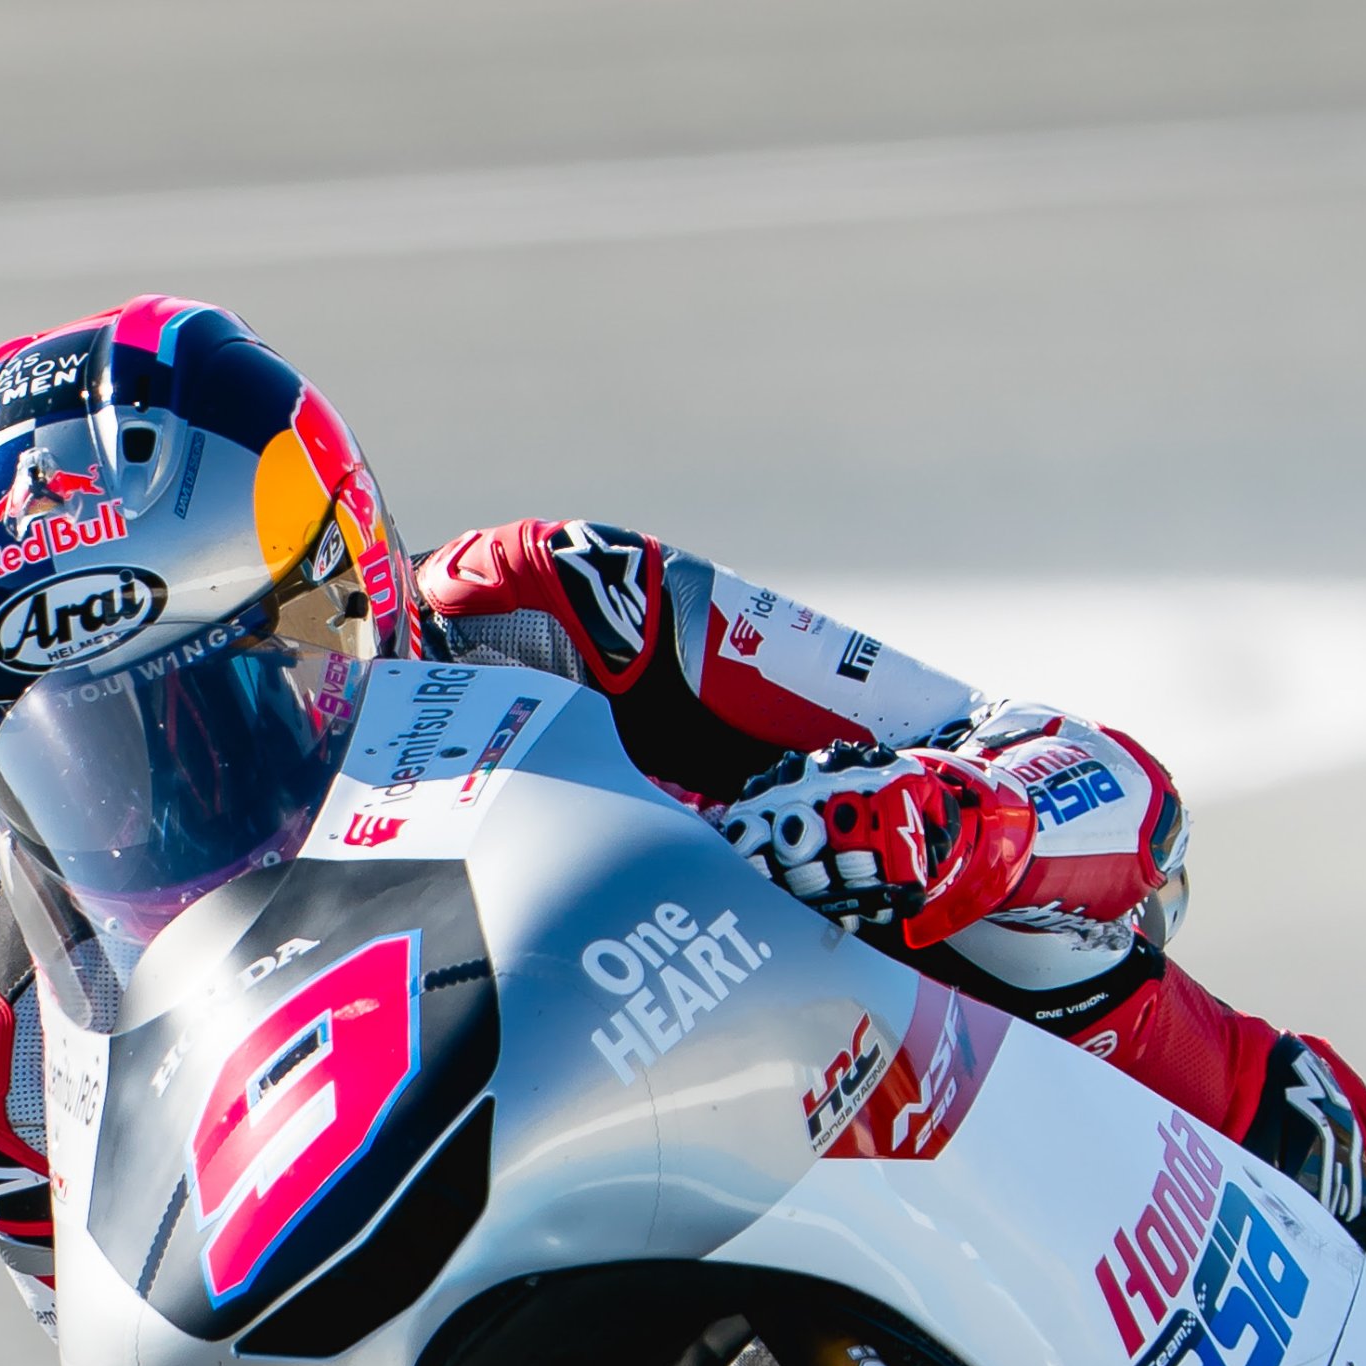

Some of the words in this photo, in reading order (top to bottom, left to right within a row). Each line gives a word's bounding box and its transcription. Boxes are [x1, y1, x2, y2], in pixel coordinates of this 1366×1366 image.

[49, 498, 127, 554] Bull
[3, 569, 146, 661] Arai
[363, 706, 455, 808] idemitsu
[412, 667, 479, 704] IRG
[582, 902, 701, 996] One
[591, 909, 772, 1087] HEART.
[185, 928, 423, 1311] 9
[801, 1009, 882, 1142] HRC
[812, 1103, 853, 1153] Honda
[852, 1056, 888, 1105] RACING
[891, 986, 959, 1152] NSF
[1094, 1108, 1224, 1360] Honda
